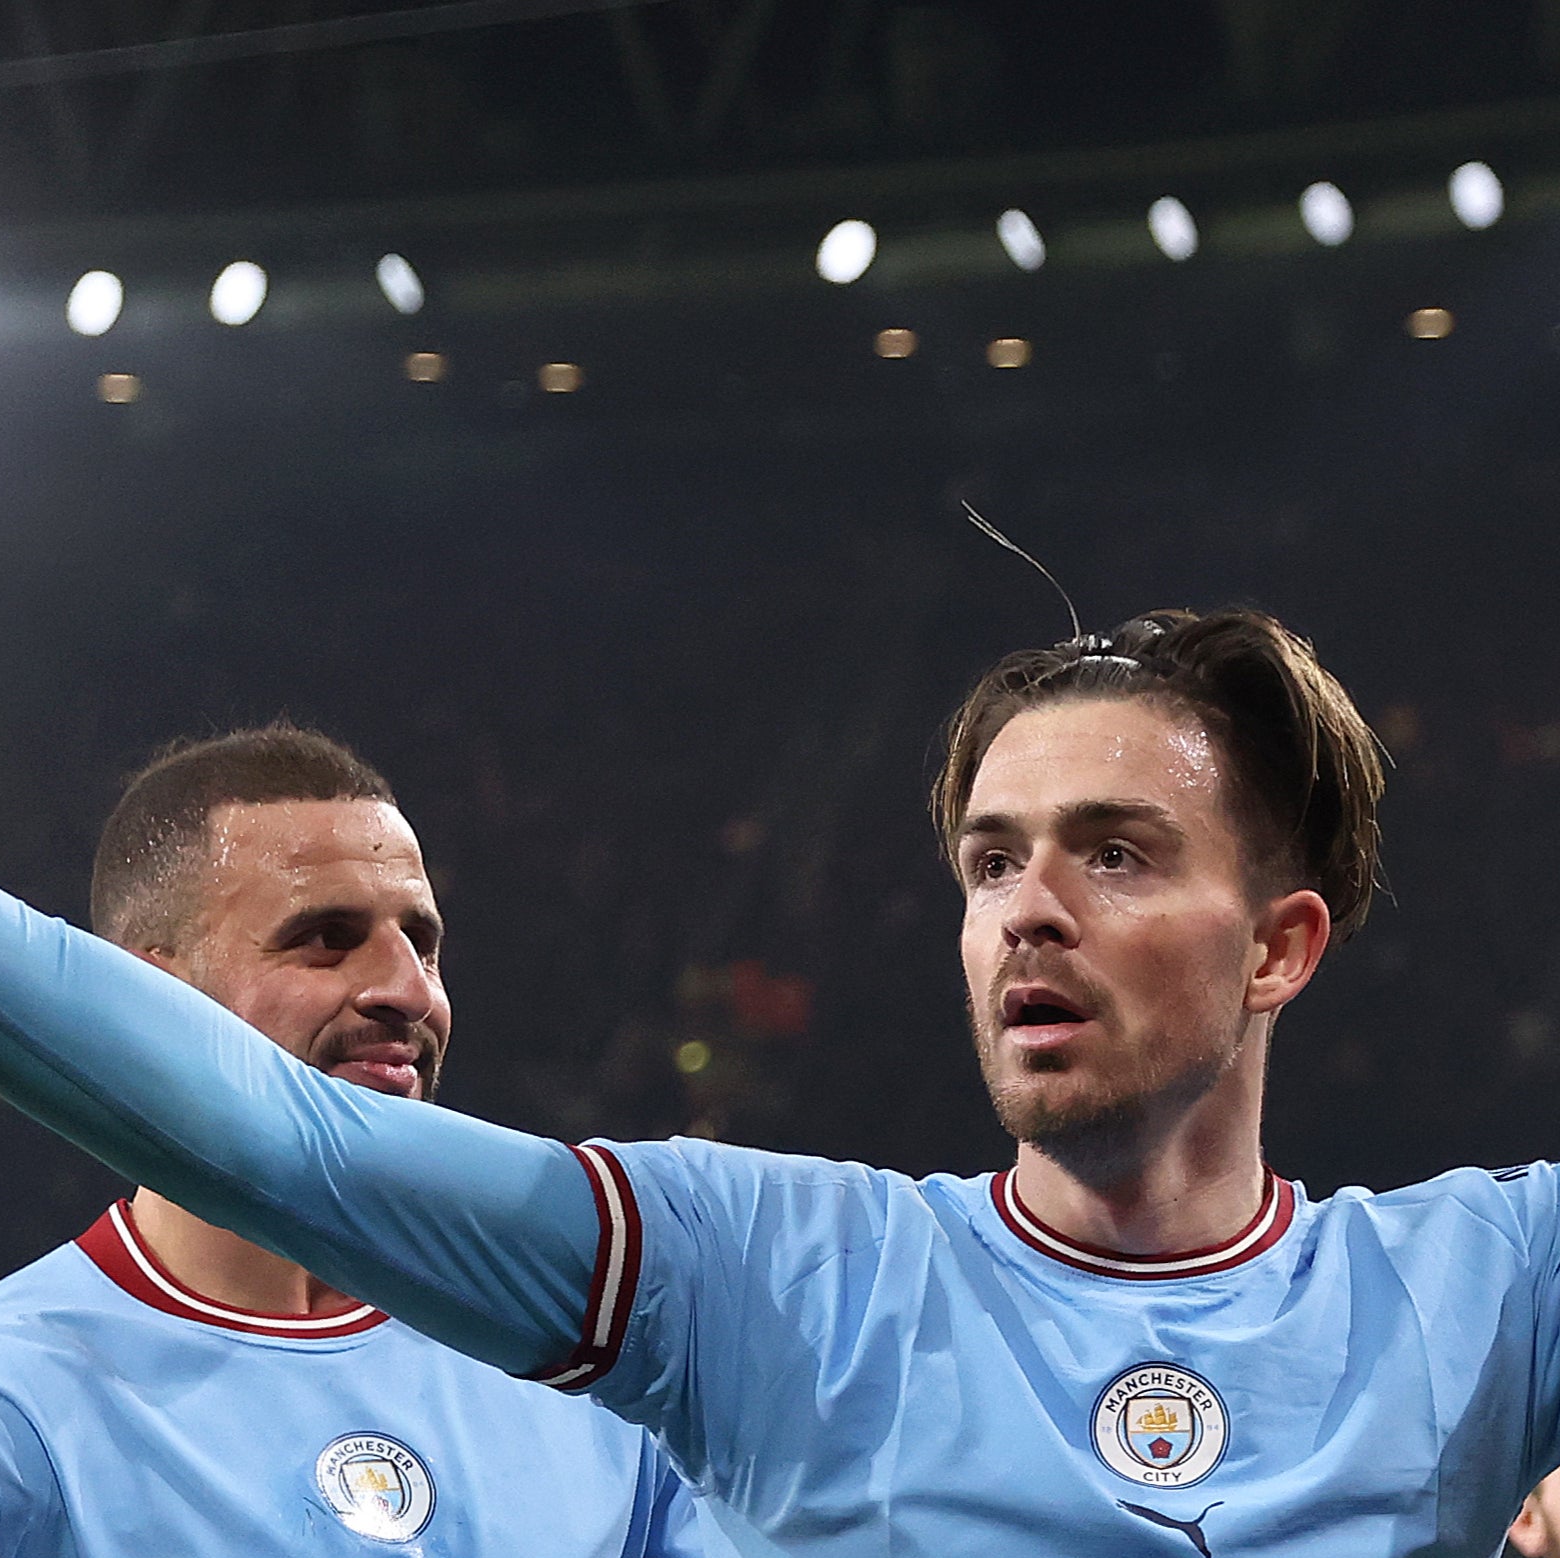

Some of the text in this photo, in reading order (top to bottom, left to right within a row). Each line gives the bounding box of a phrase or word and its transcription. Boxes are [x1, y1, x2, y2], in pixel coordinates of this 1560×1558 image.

[1105, 1372, 1213, 1413] MANCHESTER
[326, 1440, 414, 1477] MANCHESTER
[1142, 1471, 1183, 1482] CITY
